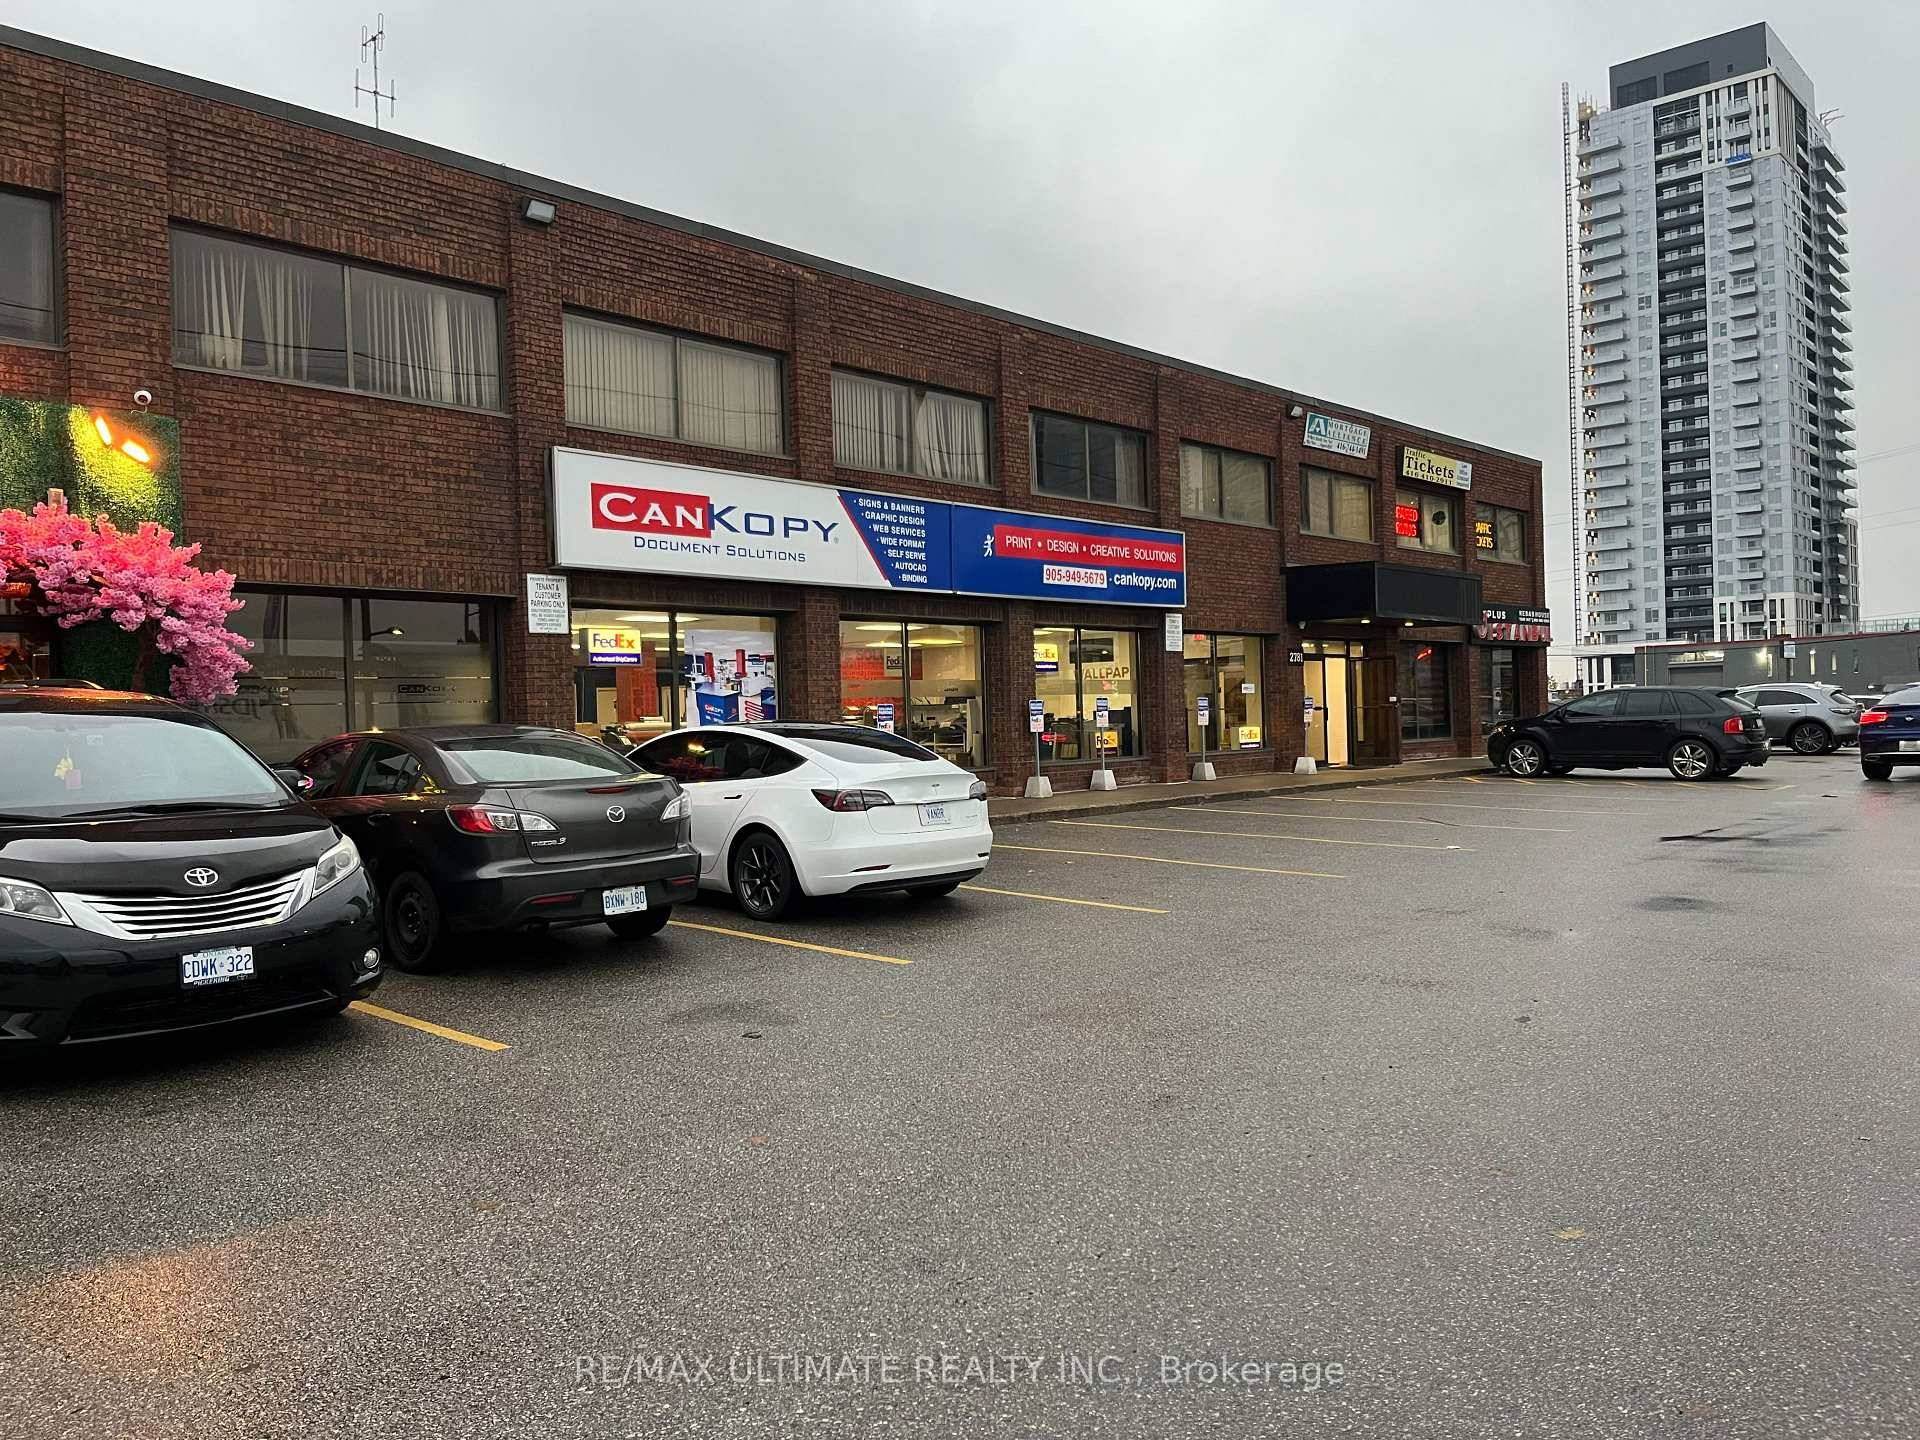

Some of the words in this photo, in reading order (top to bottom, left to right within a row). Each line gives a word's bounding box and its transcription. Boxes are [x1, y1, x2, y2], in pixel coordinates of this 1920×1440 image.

[1328, 421, 1366, 436] MORTGAGE
[1406, 448, 1426, 458] Traffic
[1405, 456, 1454, 479] Tickets
[859, 498, 882, 509] SIGNS
[884, 502, 889, 510] &
[891, 503, 925, 514] BANNERS
[865, 511, 897, 522] GRAPHIC
[900, 516, 925, 526] DESIGN
[873, 524, 889, 533] WEB
[892, 526, 926, 538] SERVICES
[634, 536, 720, 555] DOCUMENT
[726, 545, 806, 562] SOLUTIONS
[880, 536, 897, 546] WIDE
[899, 538, 925, 549] FORMAT
[1005, 535, 1033, 550] PRINT
[1047, 539, 1079, 553] DESIGN
[1090, 544, 1131, 559] CREATIVE
[1134, 548, 1177, 563] SOLUTIONS
[888, 549, 904, 558] SELF
[905, 550, 927, 561] SERVE
[895, 562, 927, 572] AUTOCAD
[536, 582, 555, 590] TENANT
[902, 574, 928, 583] BINDING
[1045, 567, 1105, 585] 905-949-5679
[1113, 572, 1177, 591] cankopy.com
[535, 591, 561, 600] CUSTOMER
[530, 599, 552, 608] PARKING
[553, 600, 566, 608] ONLY
[593, 633, 635, 648] FedEx
[605, 894, 624, 908] BXNW
[631, 891, 645, 905] 180
[183, 958, 217, 978] CDWK
[227, 953, 252, 972] 322
